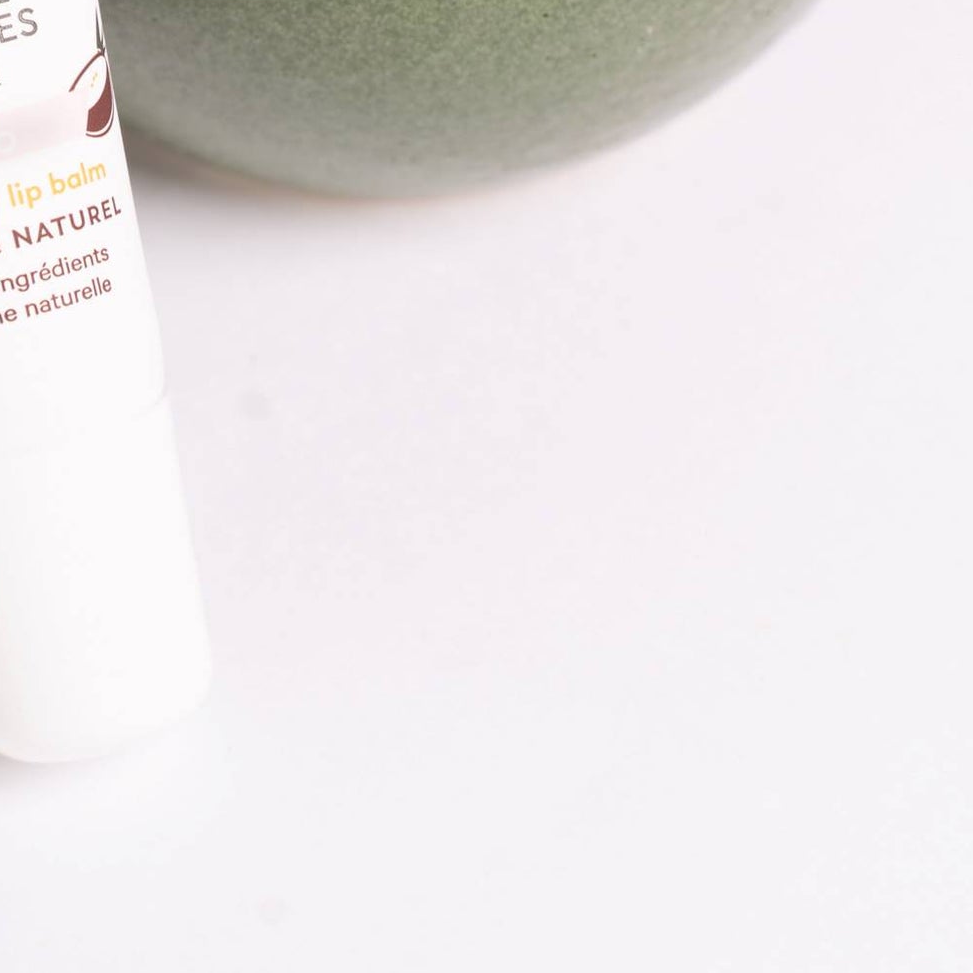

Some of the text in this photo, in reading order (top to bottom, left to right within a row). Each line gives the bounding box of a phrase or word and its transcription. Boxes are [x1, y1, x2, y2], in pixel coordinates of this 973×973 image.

[8, 183, 42, 208] lip
[49, 161, 106, 195] balm
[13, 196, 121, 249] NATUREL
[24, 277, 113, 318] naturelle
